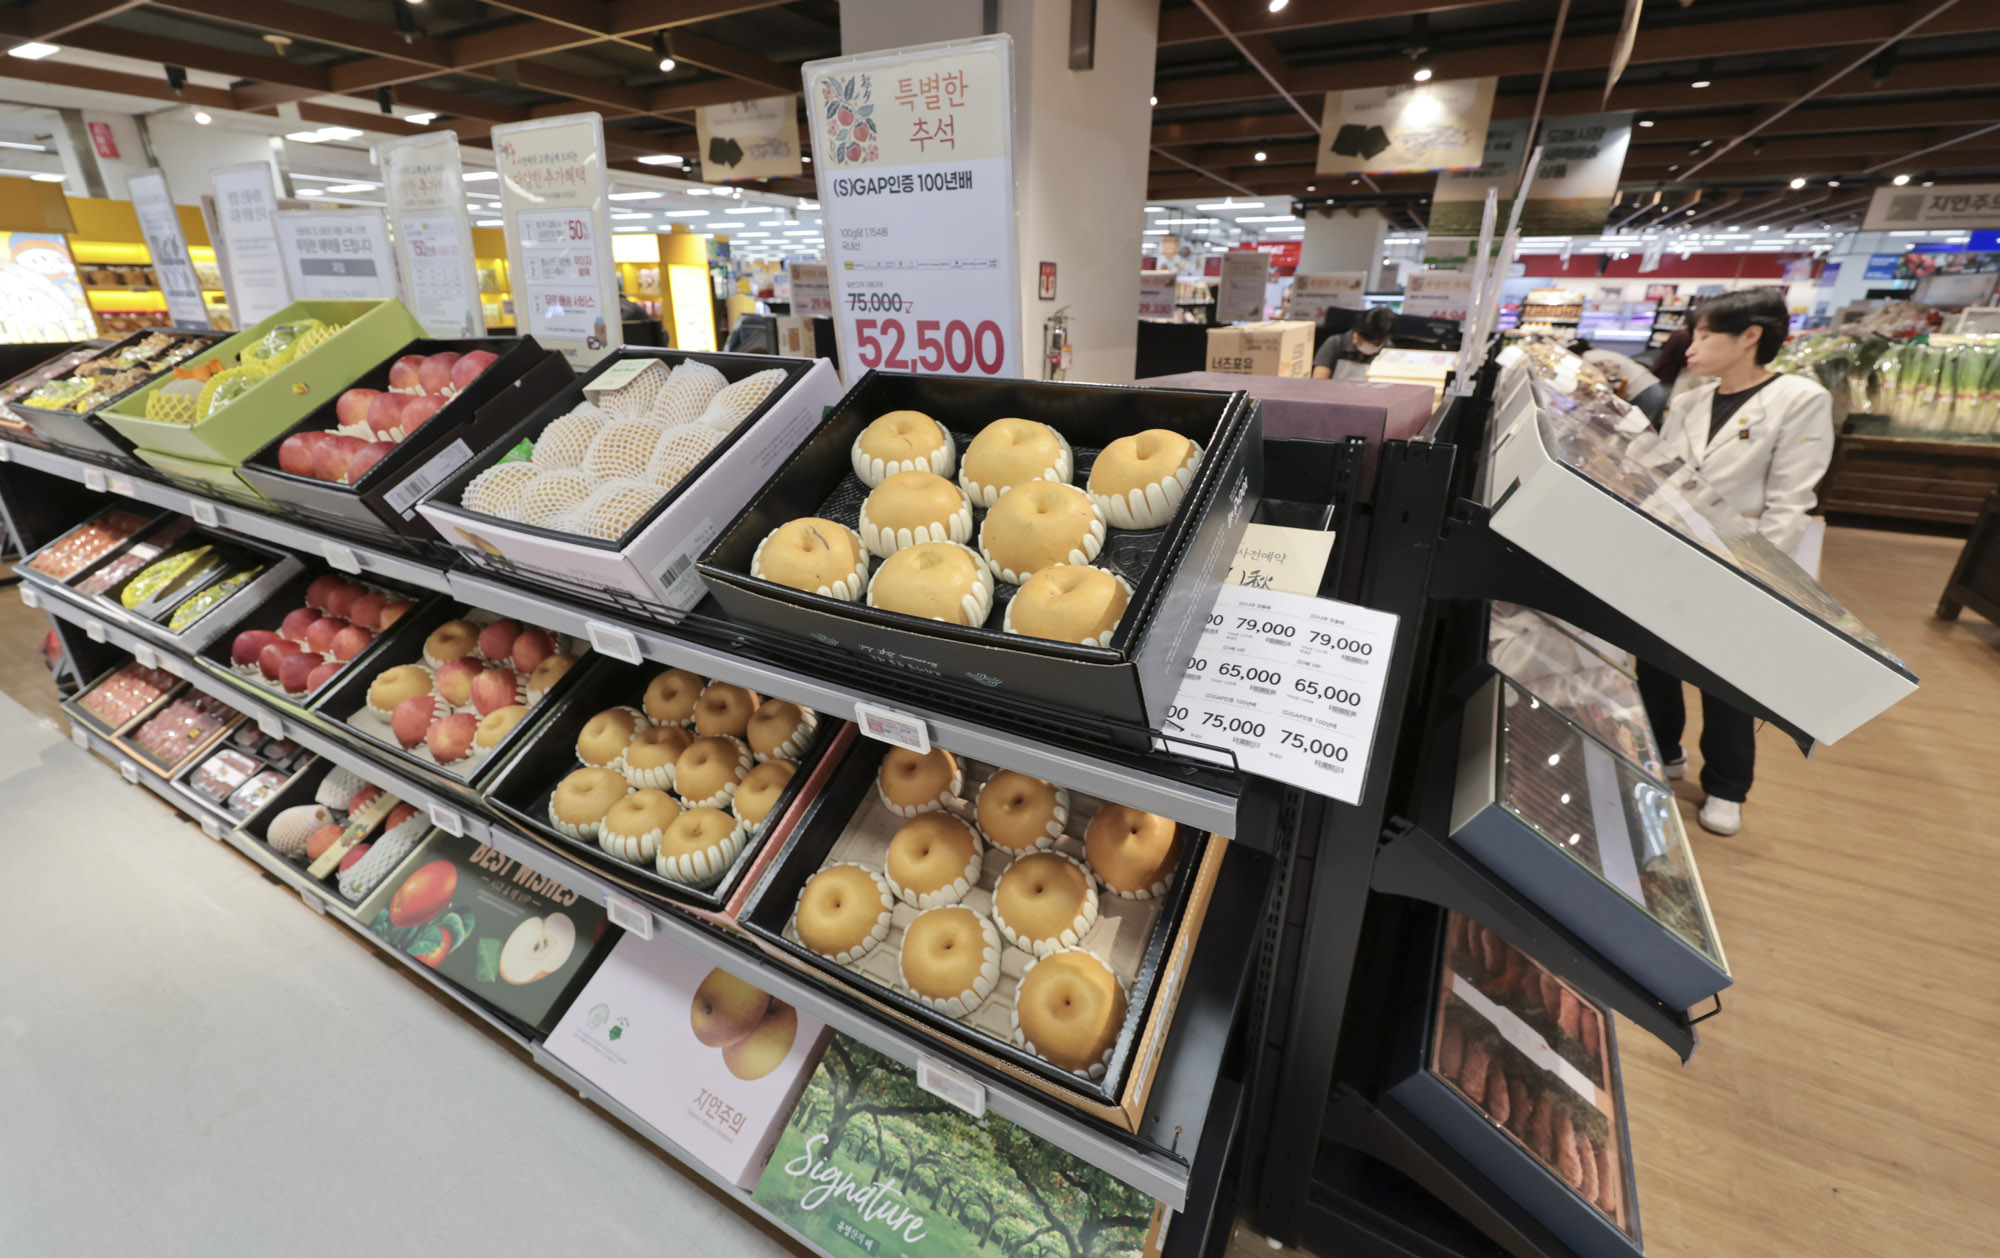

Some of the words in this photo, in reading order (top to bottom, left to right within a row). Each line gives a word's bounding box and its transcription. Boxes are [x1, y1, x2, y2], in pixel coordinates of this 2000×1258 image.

[894, 69, 969, 112] 특별한
[909, 113, 956, 153] 추석
[833, 174, 915, 198] (S)GAP인증
[918, 170, 973, 193] 100년배
[847, 292, 903, 313] 75,000
[855, 318, 1005, 375] 52,500
[1211, 357, 1254, 371] 너츠포유
[1237, 547, 1288, 565] 사전예약
[1235, 617, 1296, 638] 79,000
[1308, 630, 1373, 656] 79,000
[1218, 662, 1282, 686] 65,000
[1294, 678, 1361, 707] 65,000
[1201, 711, 1266, 738] 75,000
[1280, 729, 1349, 763] 75,000
[468, 843, 515, 876] BEST
[512, 863, 580, 907] WISHES
[784, 1133, 928, 1243] Signature
